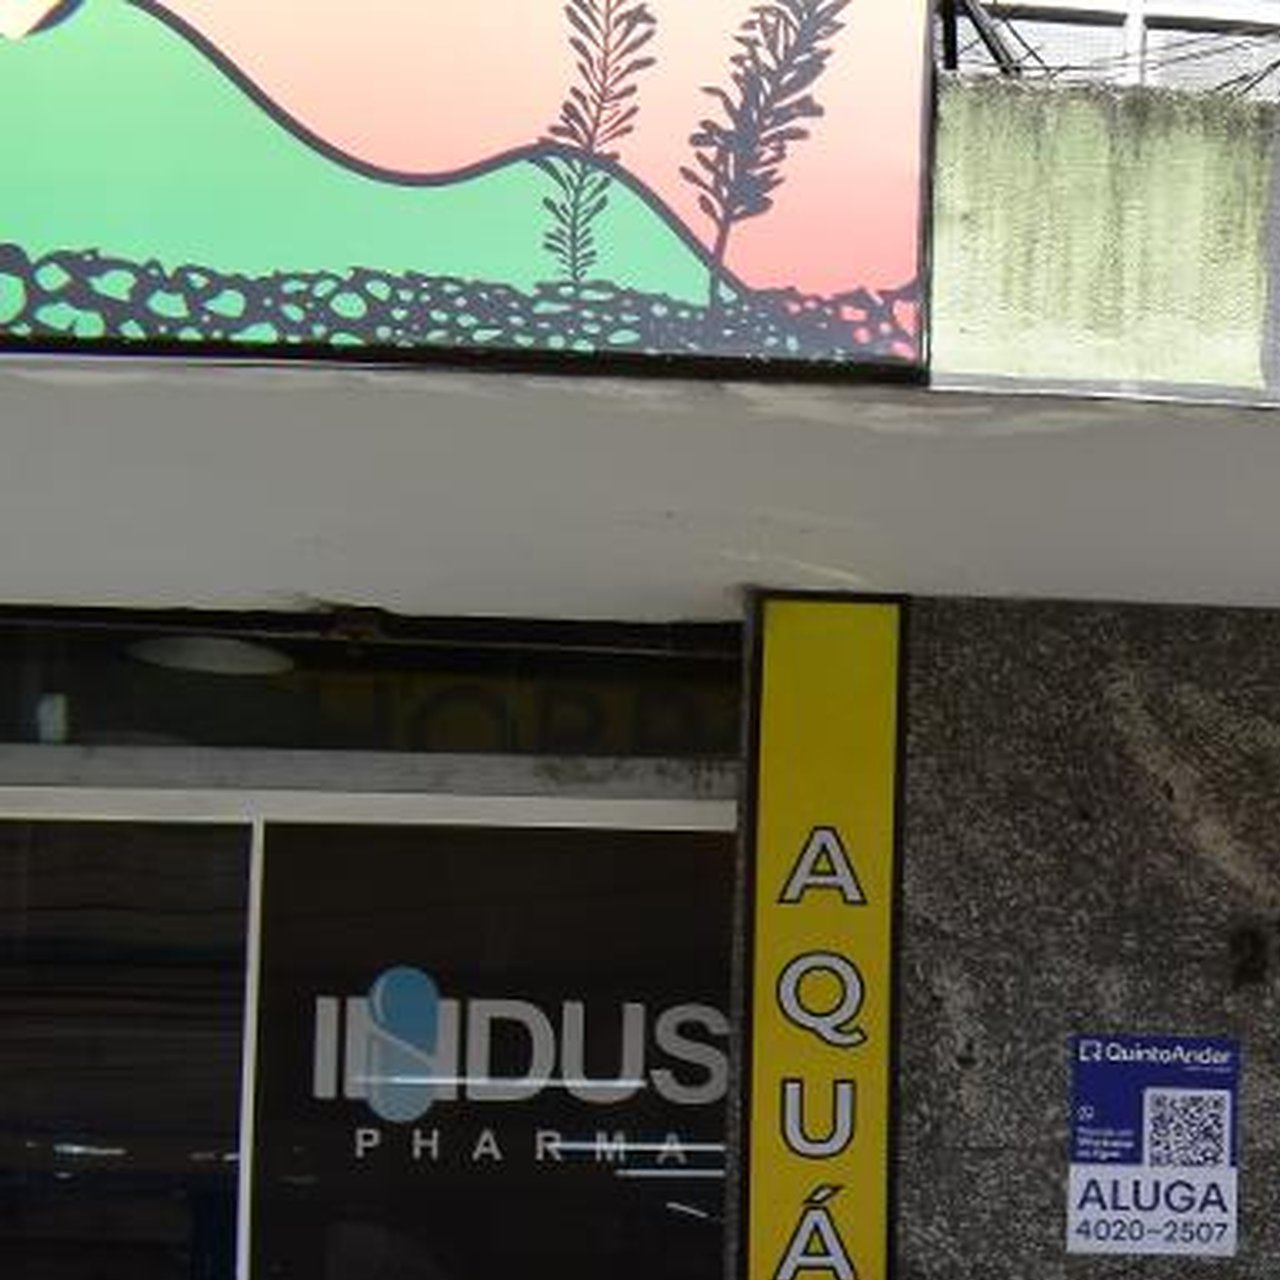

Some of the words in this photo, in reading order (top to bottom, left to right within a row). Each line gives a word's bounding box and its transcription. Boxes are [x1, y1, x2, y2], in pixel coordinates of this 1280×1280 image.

[312, 994, 732, 1104] INDUS
[1105, 1042, 1231, 1065] QuintoAndar
[355, 1127, 689, 1164] PHARMA
[1077, 1178, 1228, 1214] ALUGA
[1075, 1218, 1228, 1244] 4020-2507
